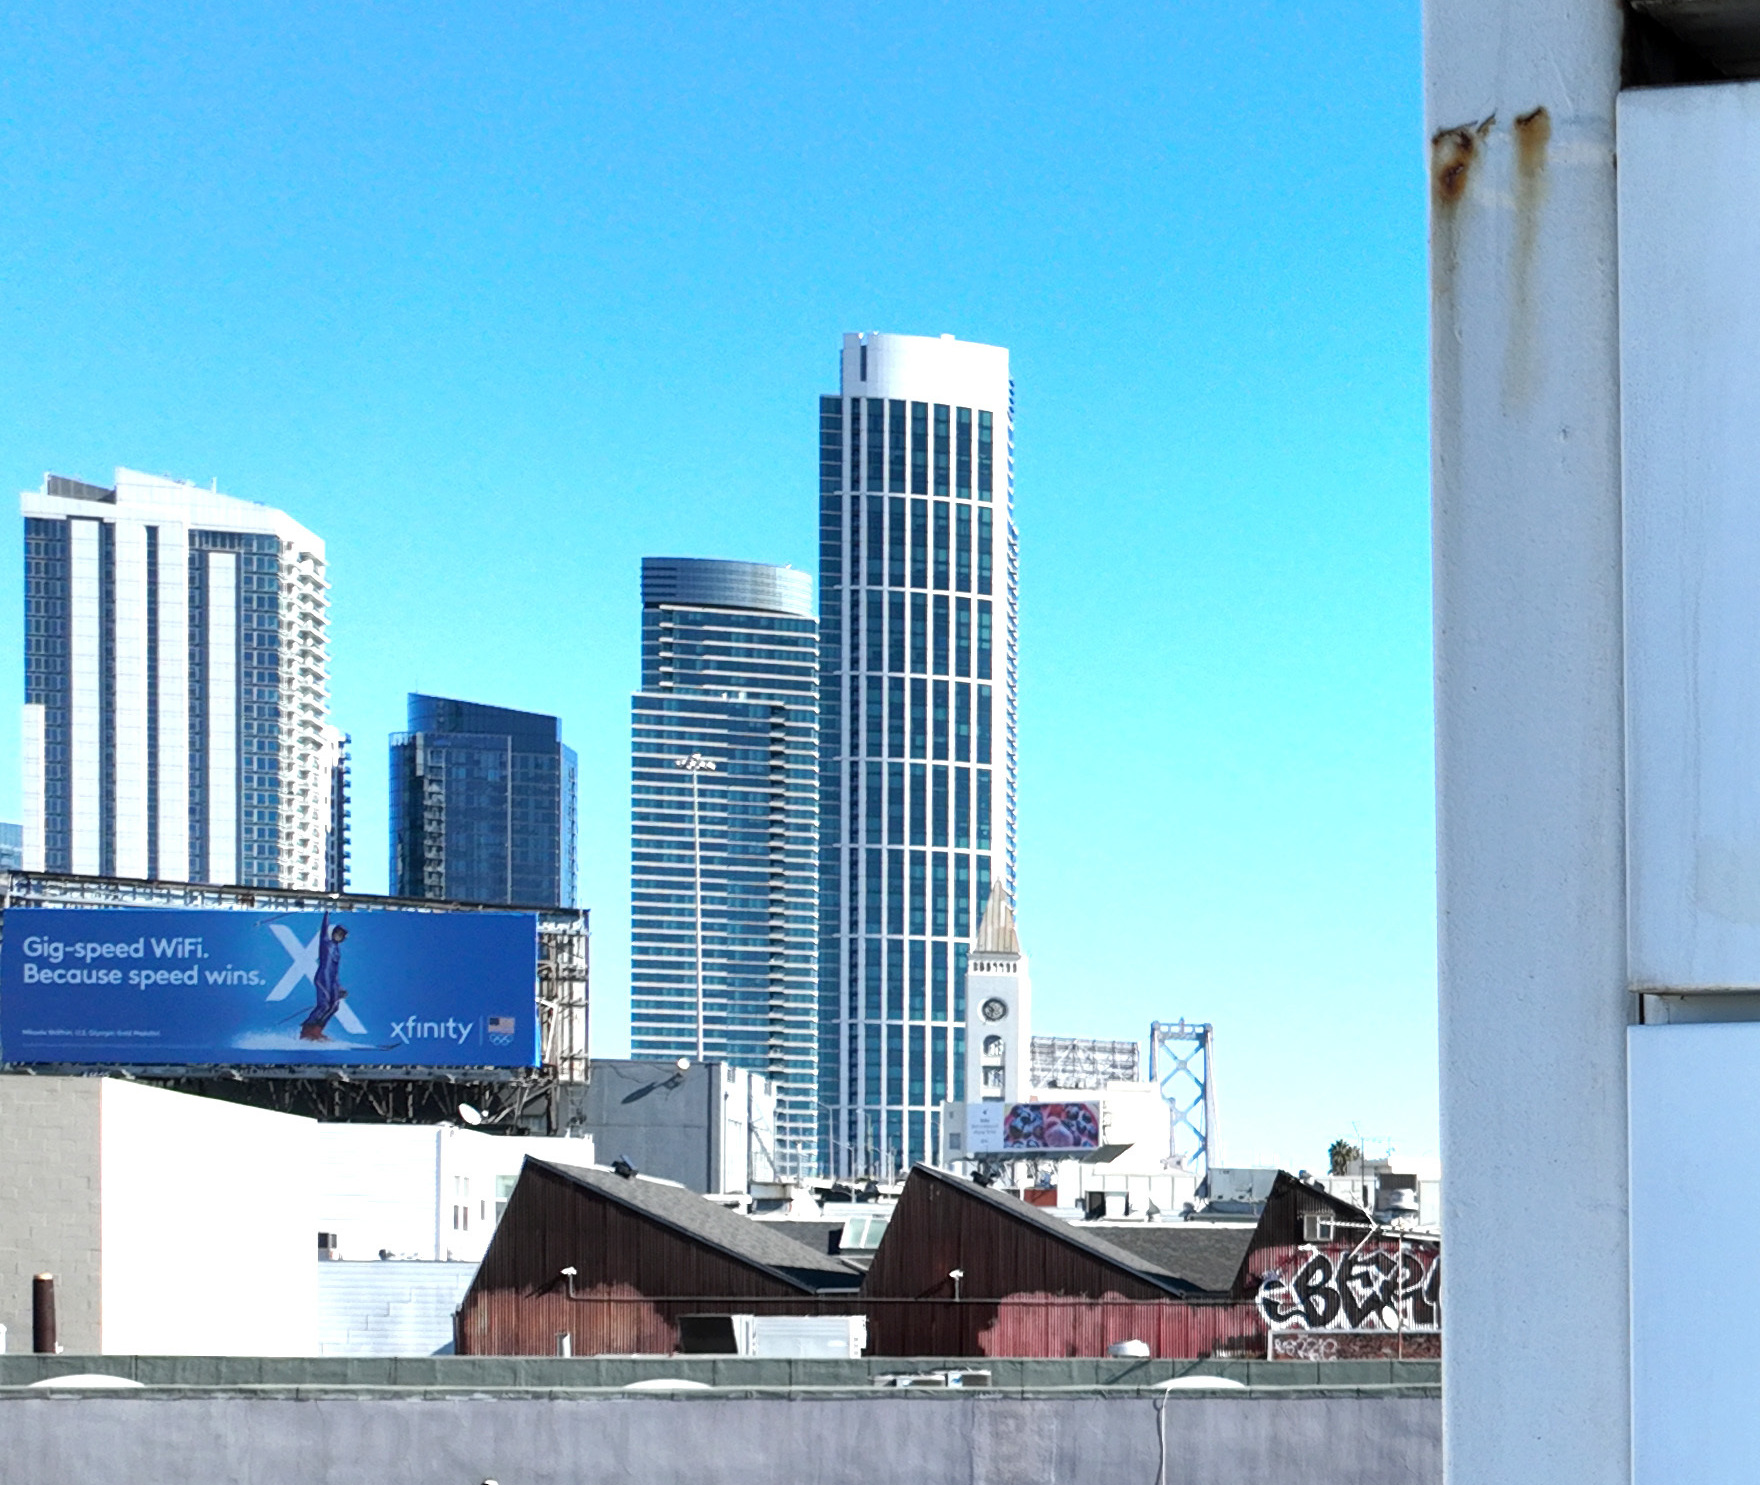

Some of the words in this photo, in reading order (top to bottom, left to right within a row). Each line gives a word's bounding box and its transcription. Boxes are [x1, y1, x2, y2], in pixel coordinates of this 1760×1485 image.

[23, 936, 145, 964] Gig-speed
[151, 937, 210, 959] WiFi.
[23, 963, 123, 985] Because
[128, 964, 199, 991] speed
[205, 964, 267, 986] wins.
[390, 1015, 475, 1045] xfinity
